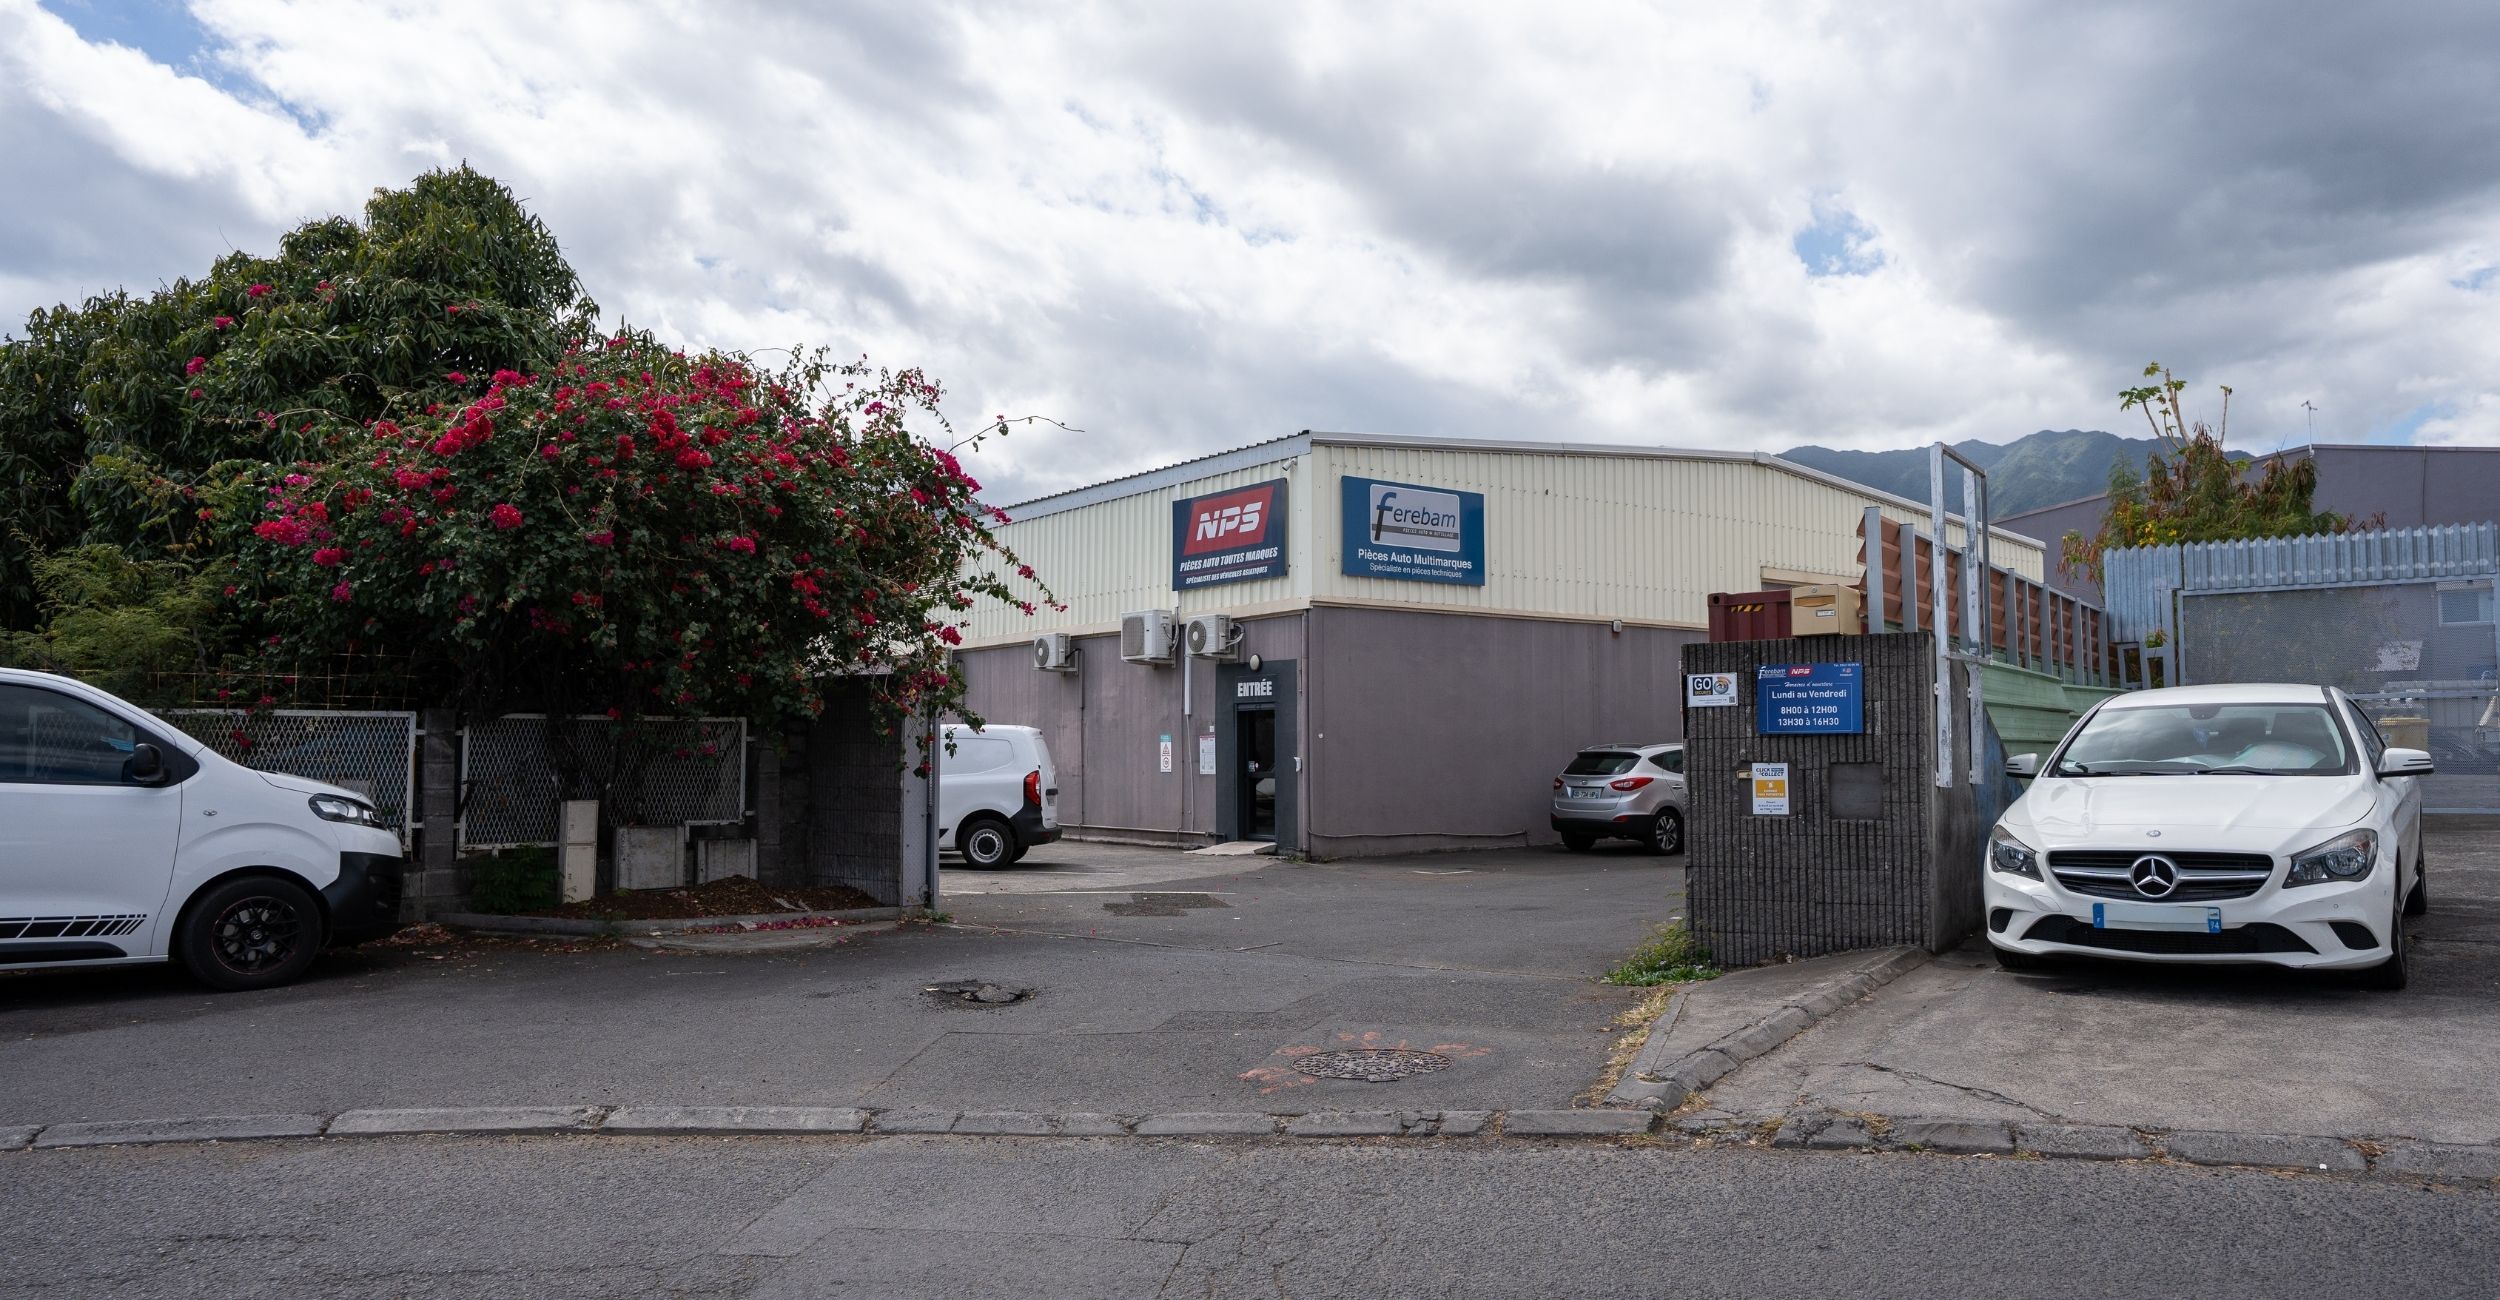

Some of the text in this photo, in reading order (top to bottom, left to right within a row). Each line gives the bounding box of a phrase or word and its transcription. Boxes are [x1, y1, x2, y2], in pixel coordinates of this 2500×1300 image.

[1196, 501, 1263, 541] NPS
[1374, 491, 1456, 541] ferebam
[1179, 547, 1279, 572] PIÈCES AUTO TOUTES MARQUES
[1358, 548, 1472, 570] Pièces Auto Multimarques
[1211, 573, 1220, 581] DES
[1242, 566, 1268, 576] ASIATIQUES
[1431, 568, 1463, 579] techniques
[1237, 678, 1272, 697] ENTRÉE
[1694, 678, 1712, 690] GO
[1771, 691, 1795, 699] Lundi
[1808, 689, 1847, 698] Vendredi
[1780, 705, 1838, 715] 8H00 à 12H00
[1778, 717, 1839, 726] 13H30 à 16H30
